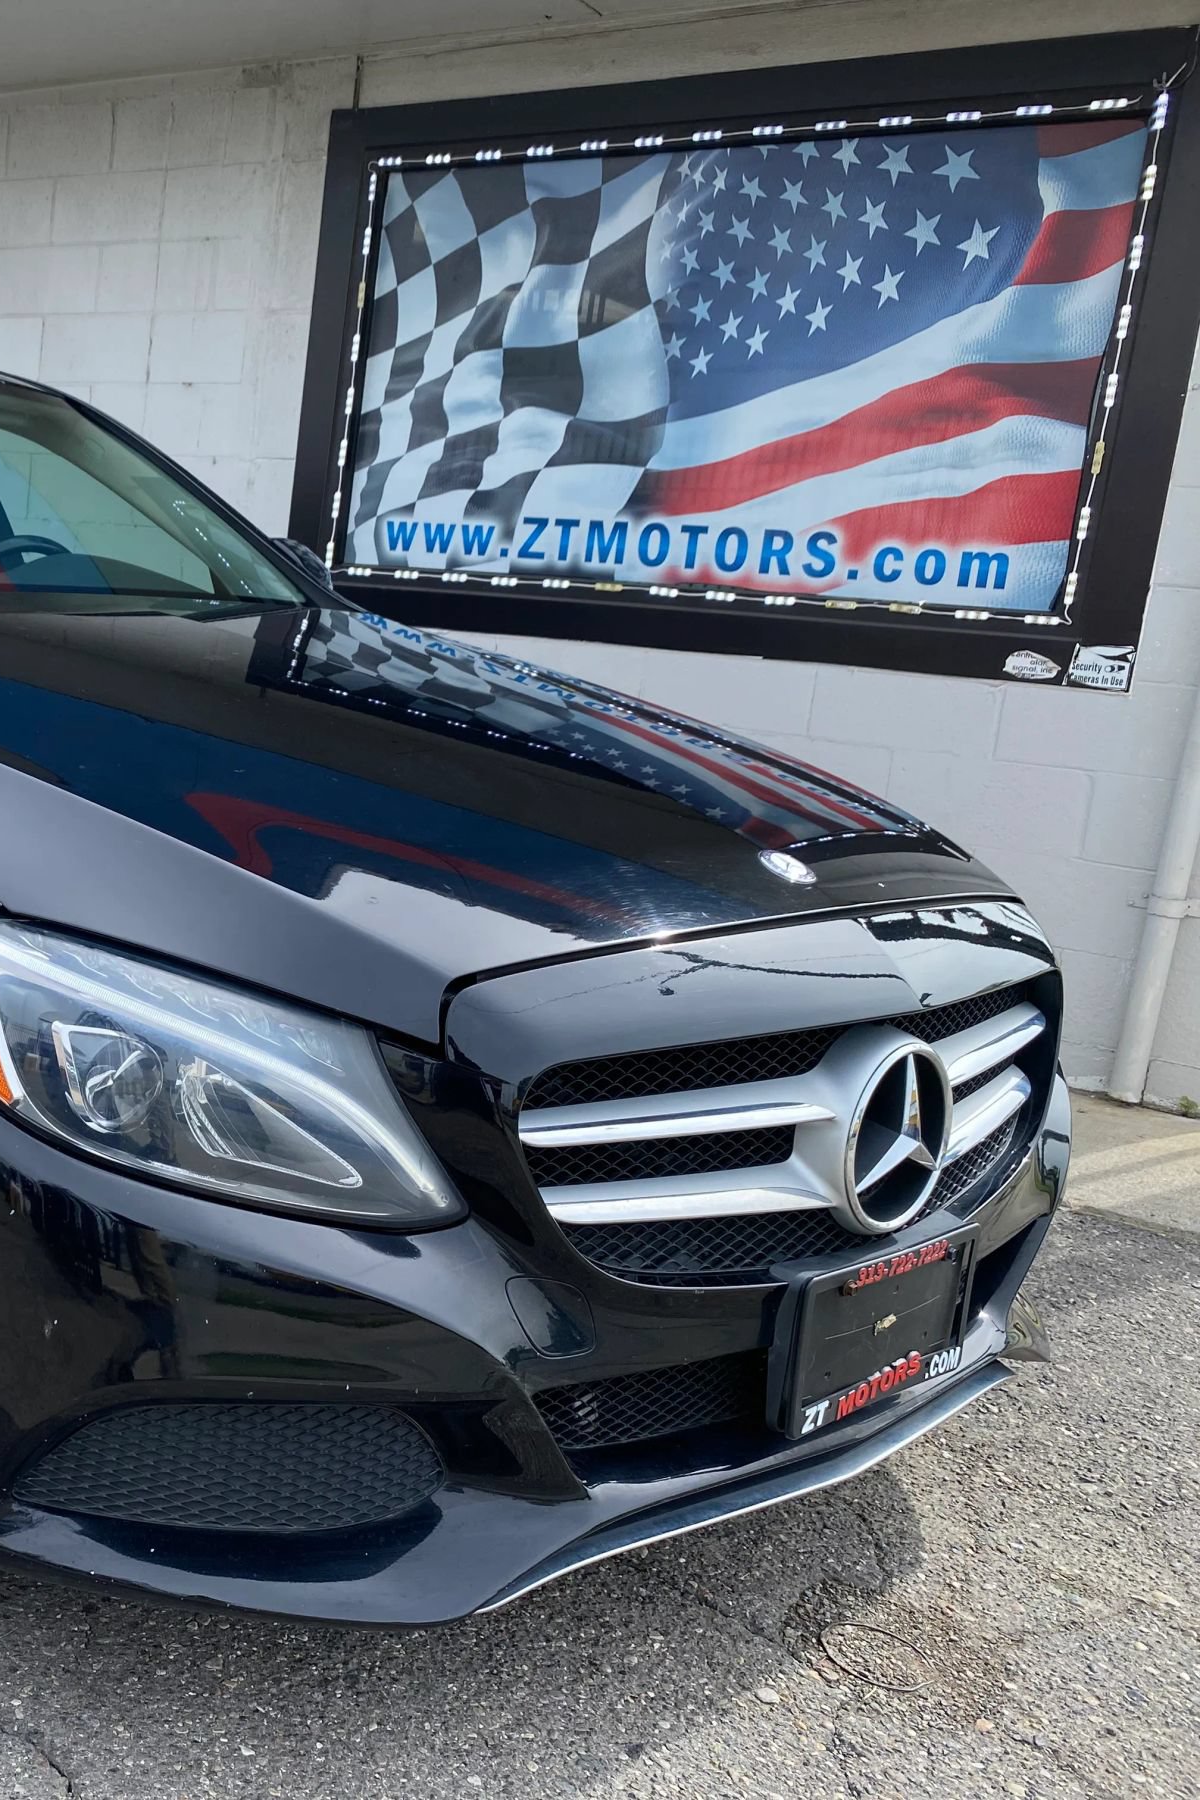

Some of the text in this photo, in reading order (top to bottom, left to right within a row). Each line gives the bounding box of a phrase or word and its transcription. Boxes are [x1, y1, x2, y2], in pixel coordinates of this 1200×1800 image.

[386, 516, 1009, 589] www.ZTMOTORS.com
[1070, 673, 1124, 687] Cameras In Use
[1071, 660, 1103, 674] Security
[856, 1239, 949, 1287] 313-722-7222
[801, 1399, 830, 1434] ZT
[836, 1350, 923, 1420] MOTORS
